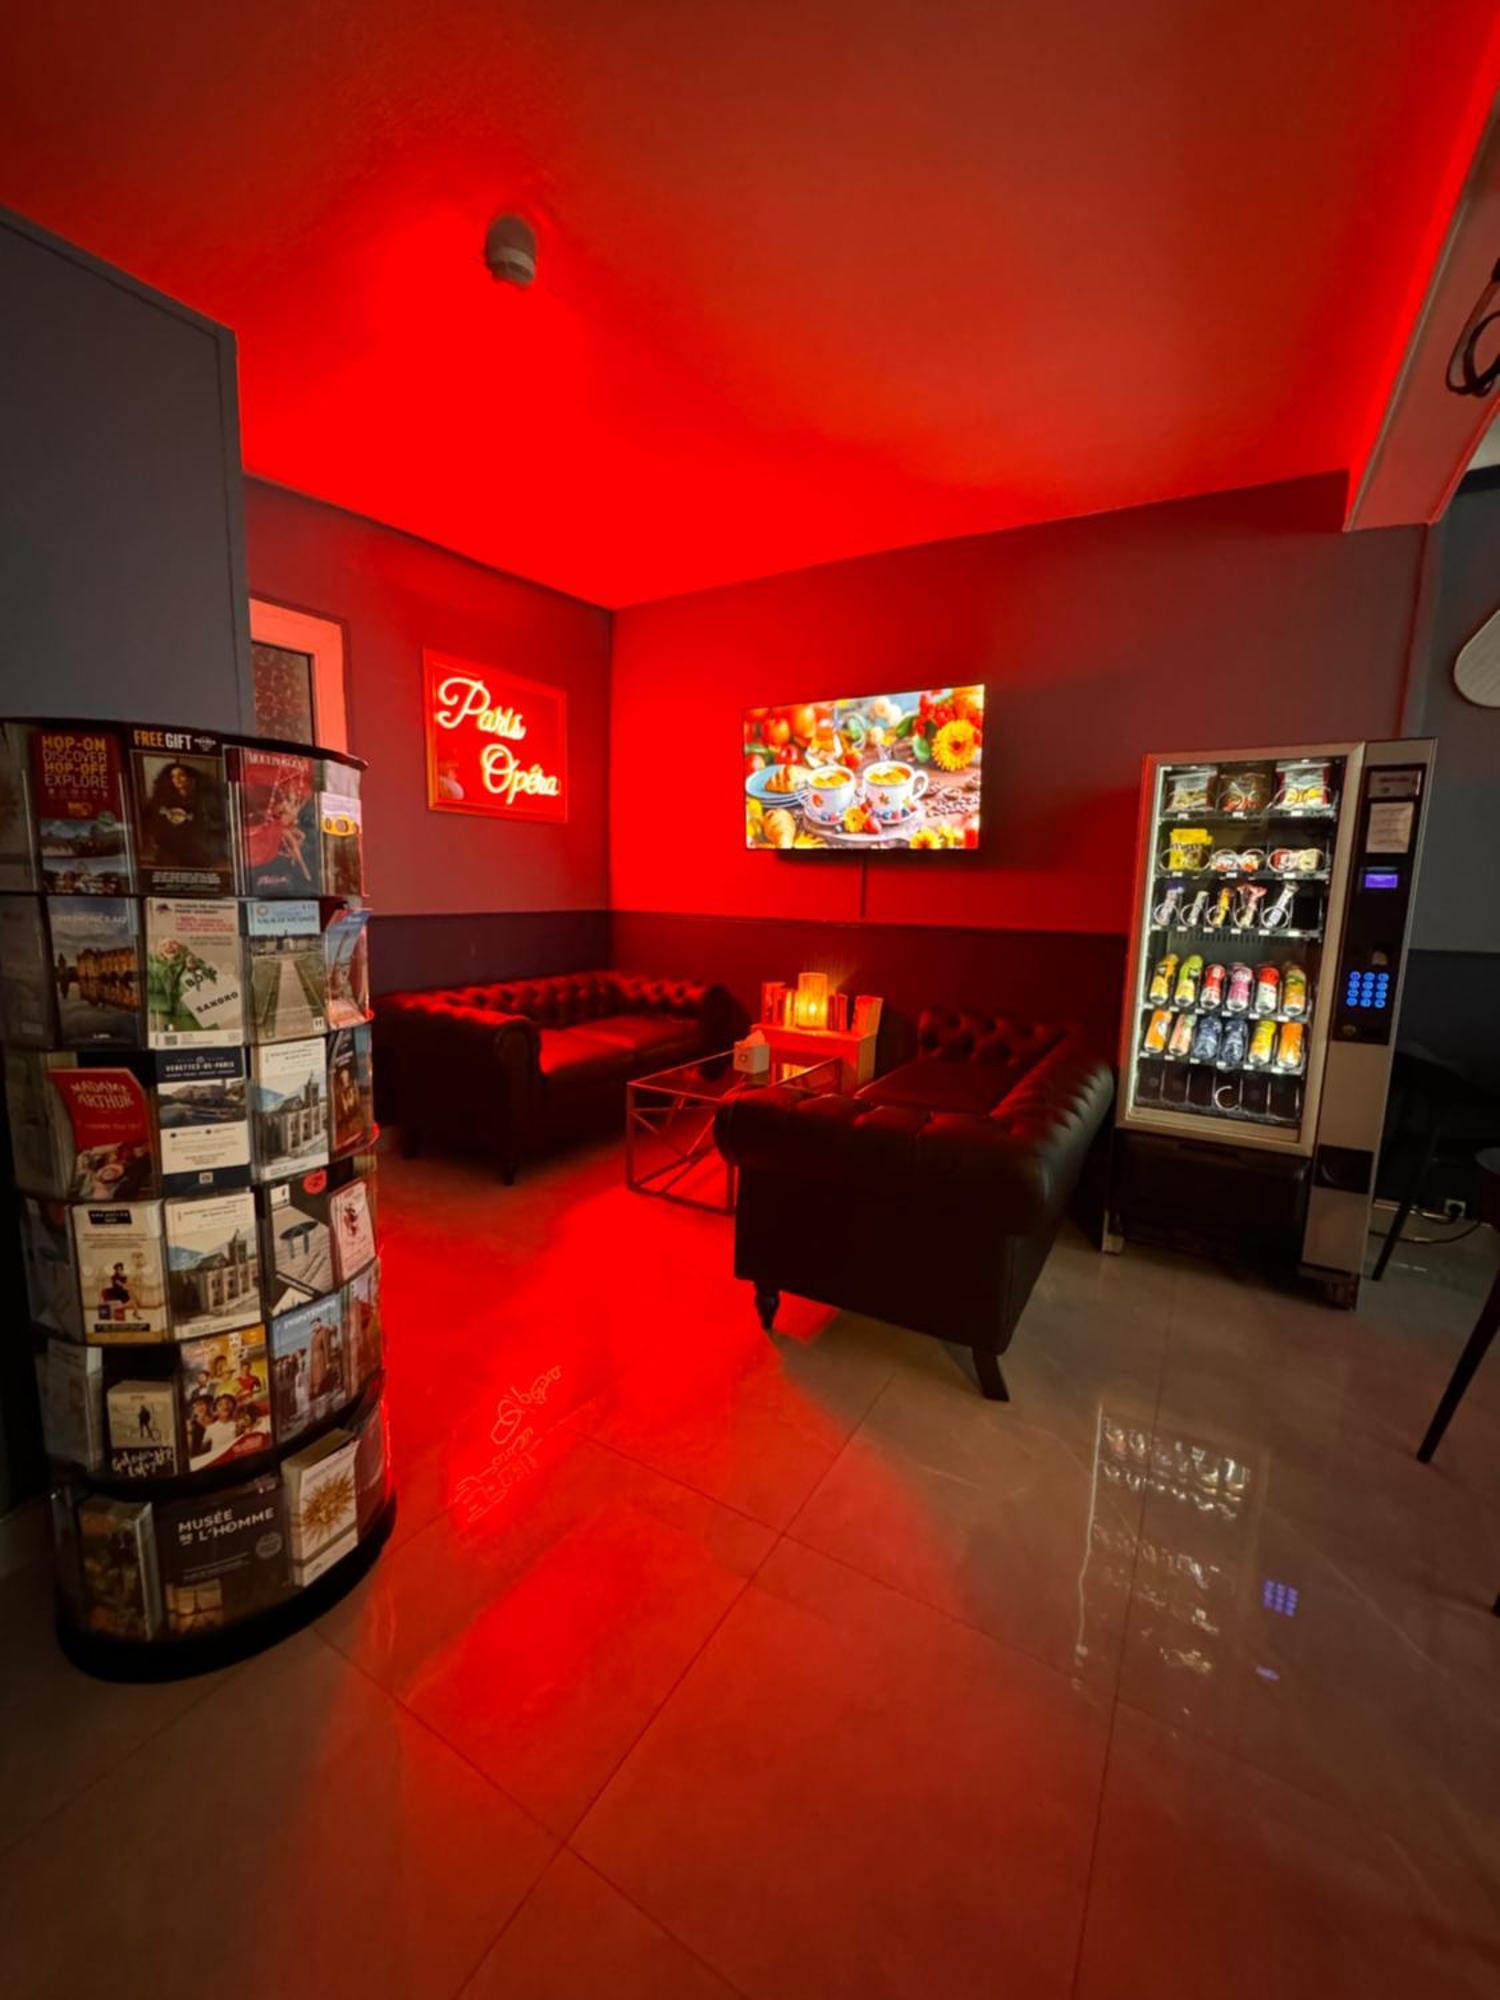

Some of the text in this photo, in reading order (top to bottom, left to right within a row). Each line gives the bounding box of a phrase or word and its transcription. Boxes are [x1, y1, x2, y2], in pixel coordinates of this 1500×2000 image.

[436, 676, 527, 740] Paris
[41, 735, 107, 751] HOP-ON
[133, 729, 164, 748] FREE
[165, 732, 192, 750] GIFT
[42, 749, 108, 763] DISCOVER
[43, 761, 108, 775] HOP-OFF
[480, 742, 559, 806] Opéra
[43, 773, 109, 789] EXPLORE
[178, 1507, 233, 1533] MUSÉE
[198, 1506, 275, 1542] L'HOMME
